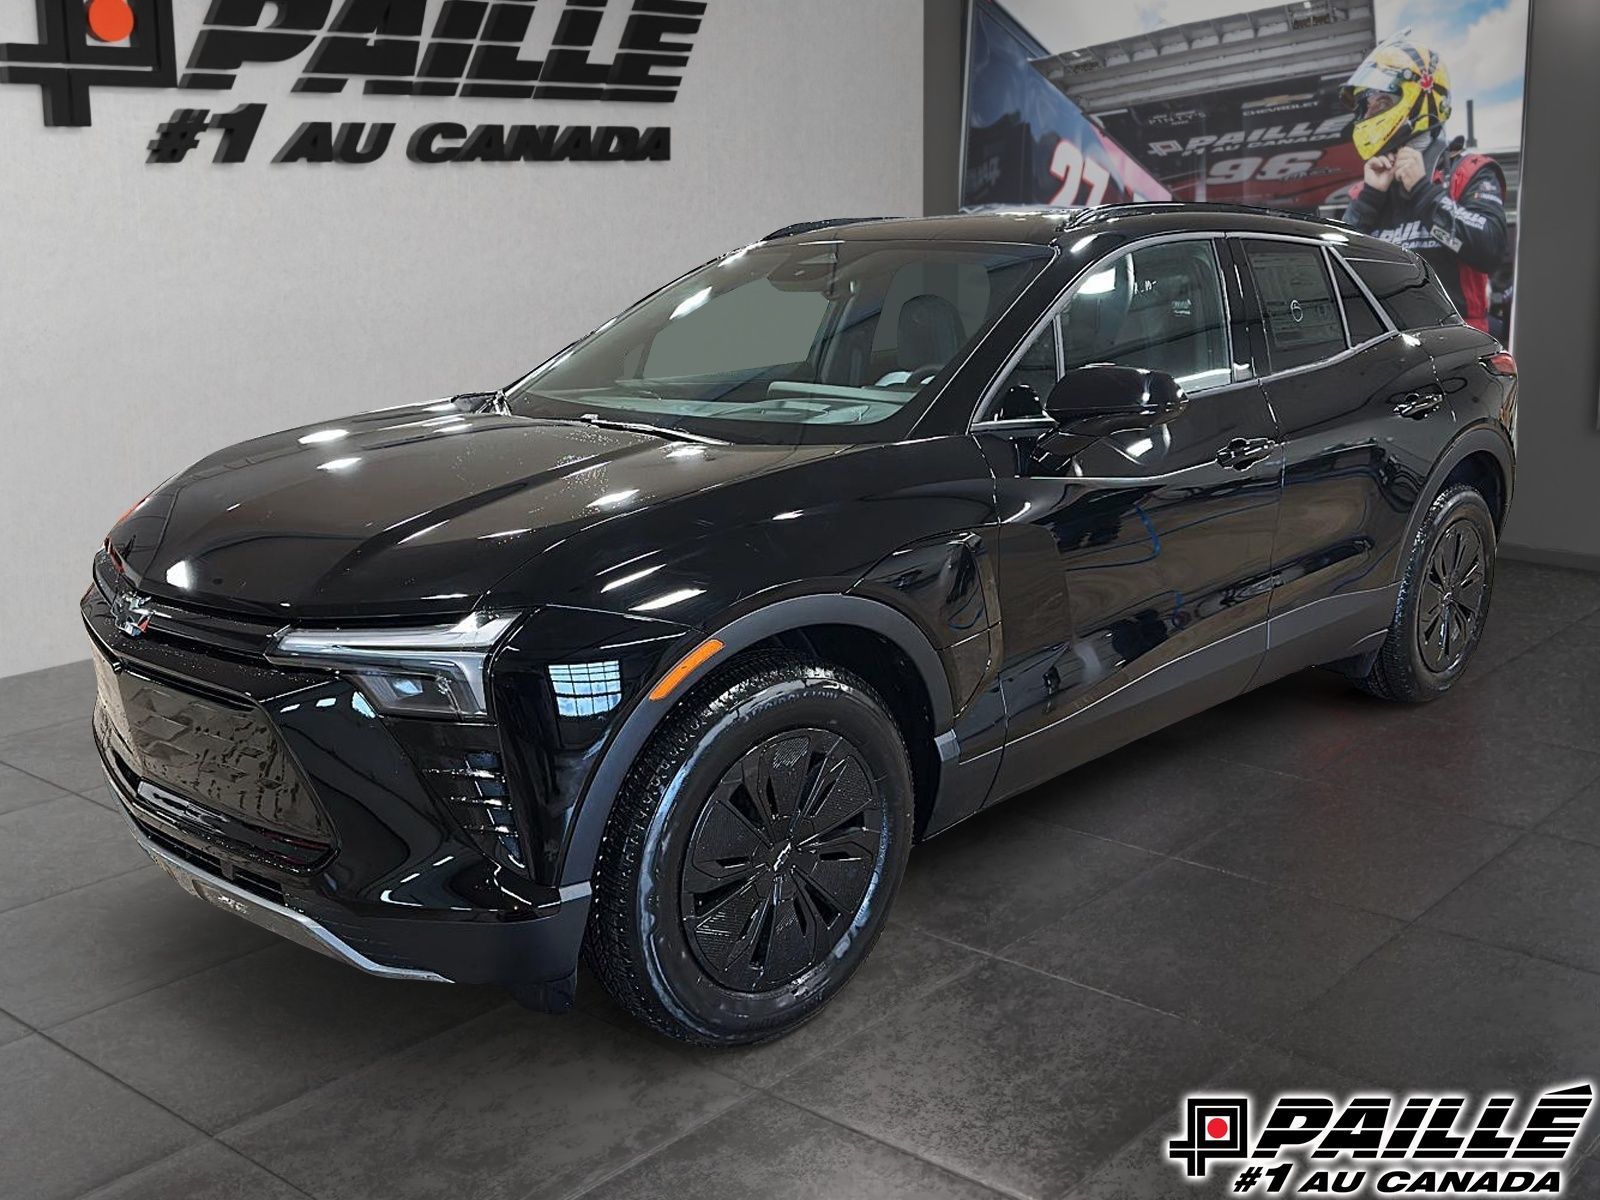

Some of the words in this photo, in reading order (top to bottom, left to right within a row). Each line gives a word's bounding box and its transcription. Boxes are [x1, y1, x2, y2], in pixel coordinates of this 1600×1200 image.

[1242, 101, 1319, 116] CHEVROLET
[146, 103, 268, 164] #1
[271, 122, 396, 164] AU
[406, 122, 672, 163] CANADA
[1214, 144, 1241, 153] AU
[1247, 133, 1341, 149] CANADA
[1049, 140, 1110, 207] 27
[1207, 150, 1322, 185] 96
